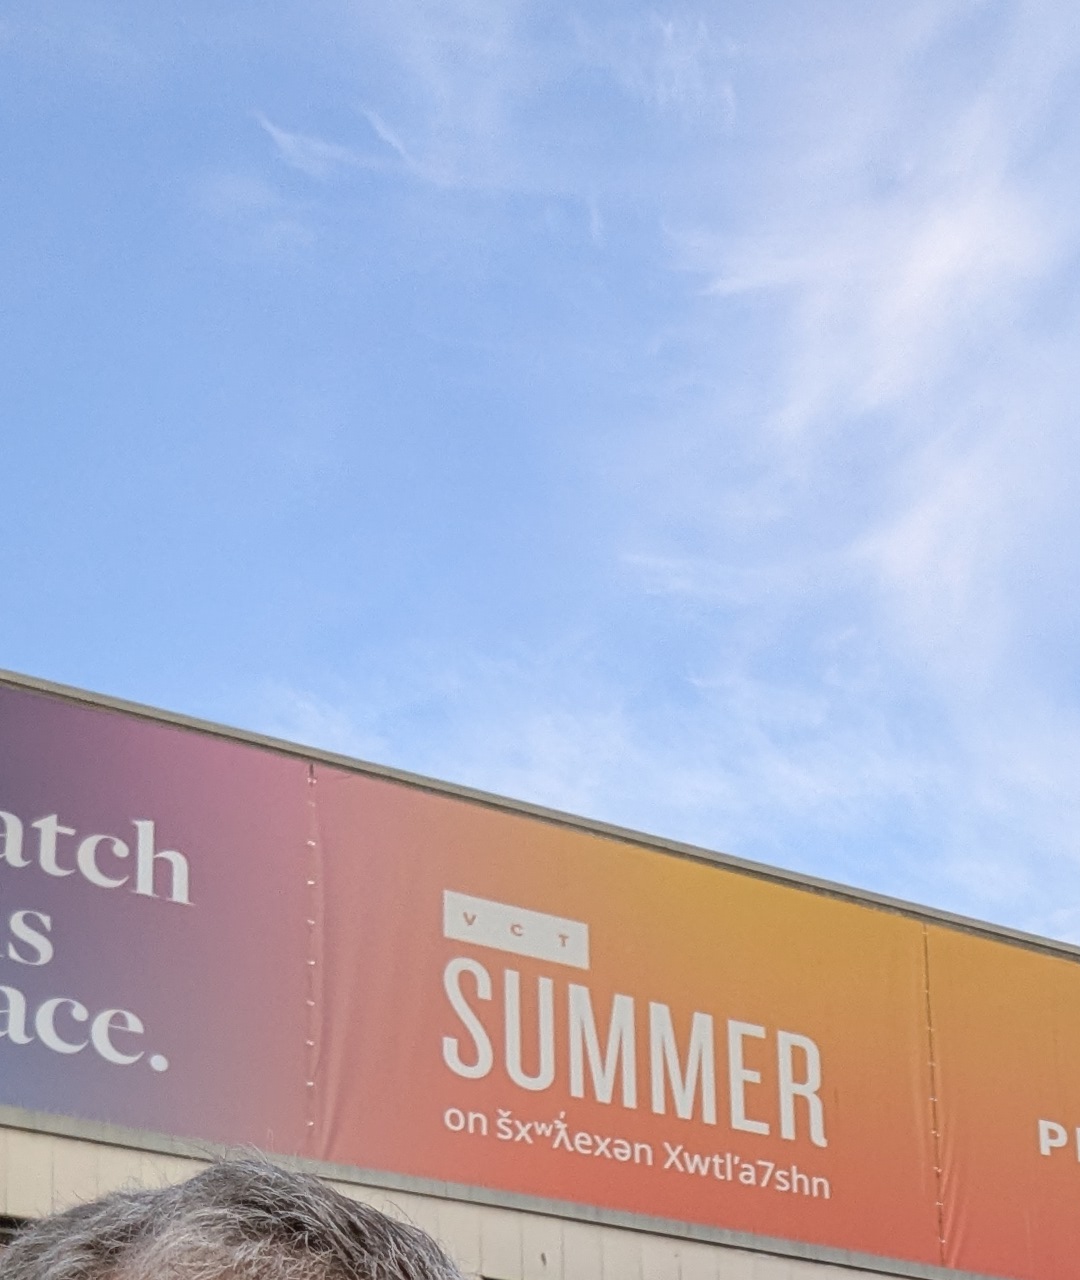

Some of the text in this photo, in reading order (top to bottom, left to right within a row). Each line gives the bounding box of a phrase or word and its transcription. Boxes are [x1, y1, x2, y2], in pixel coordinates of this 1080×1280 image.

[0, 910, 54, 966] s
[442, 956, 829, 1147] SUMMER
[444, 1107, 488, 1136] on
